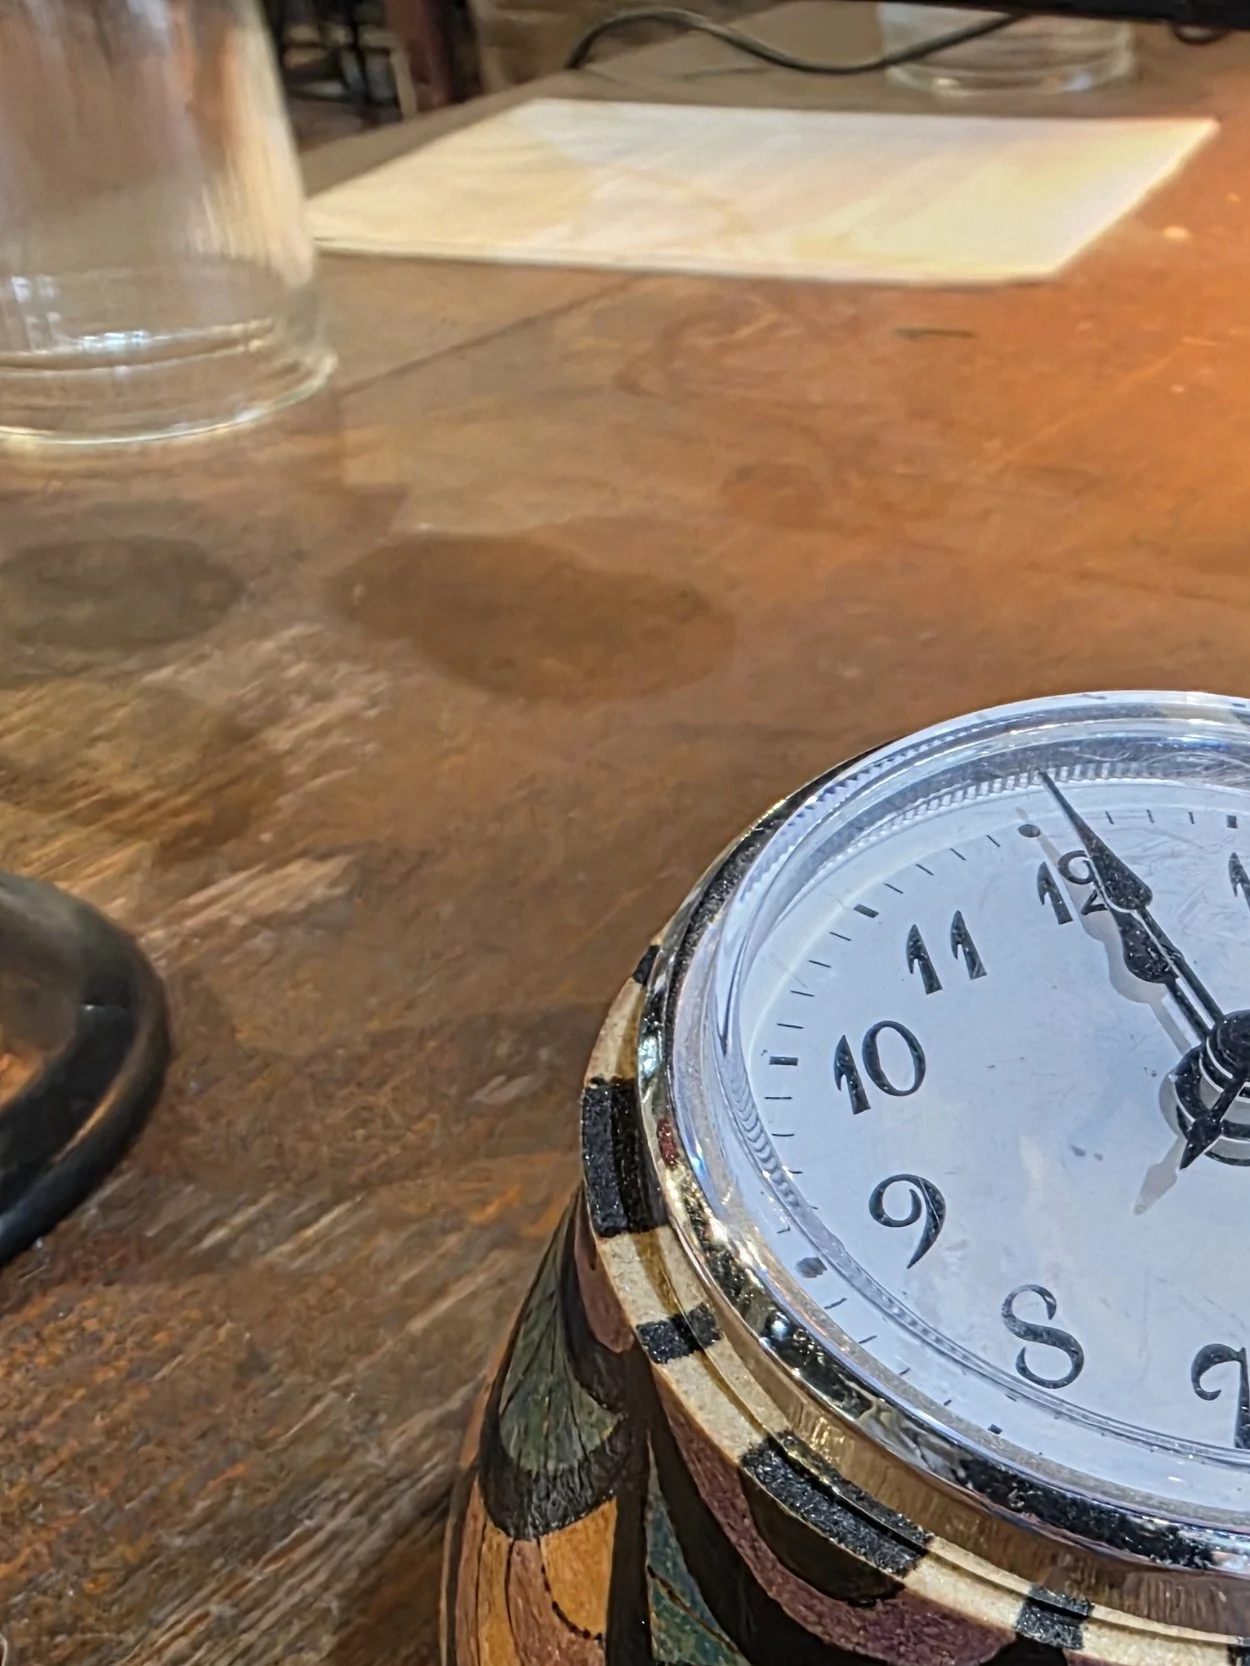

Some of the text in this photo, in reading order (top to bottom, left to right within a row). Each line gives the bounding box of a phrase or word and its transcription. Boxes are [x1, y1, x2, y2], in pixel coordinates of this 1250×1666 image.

[905, 910, 988, 996] 11
[833, 1020, 927, 1116] 10
[868, 1173, 946, 1270] 9
[1000, 1284, 1085, 1390] 8
